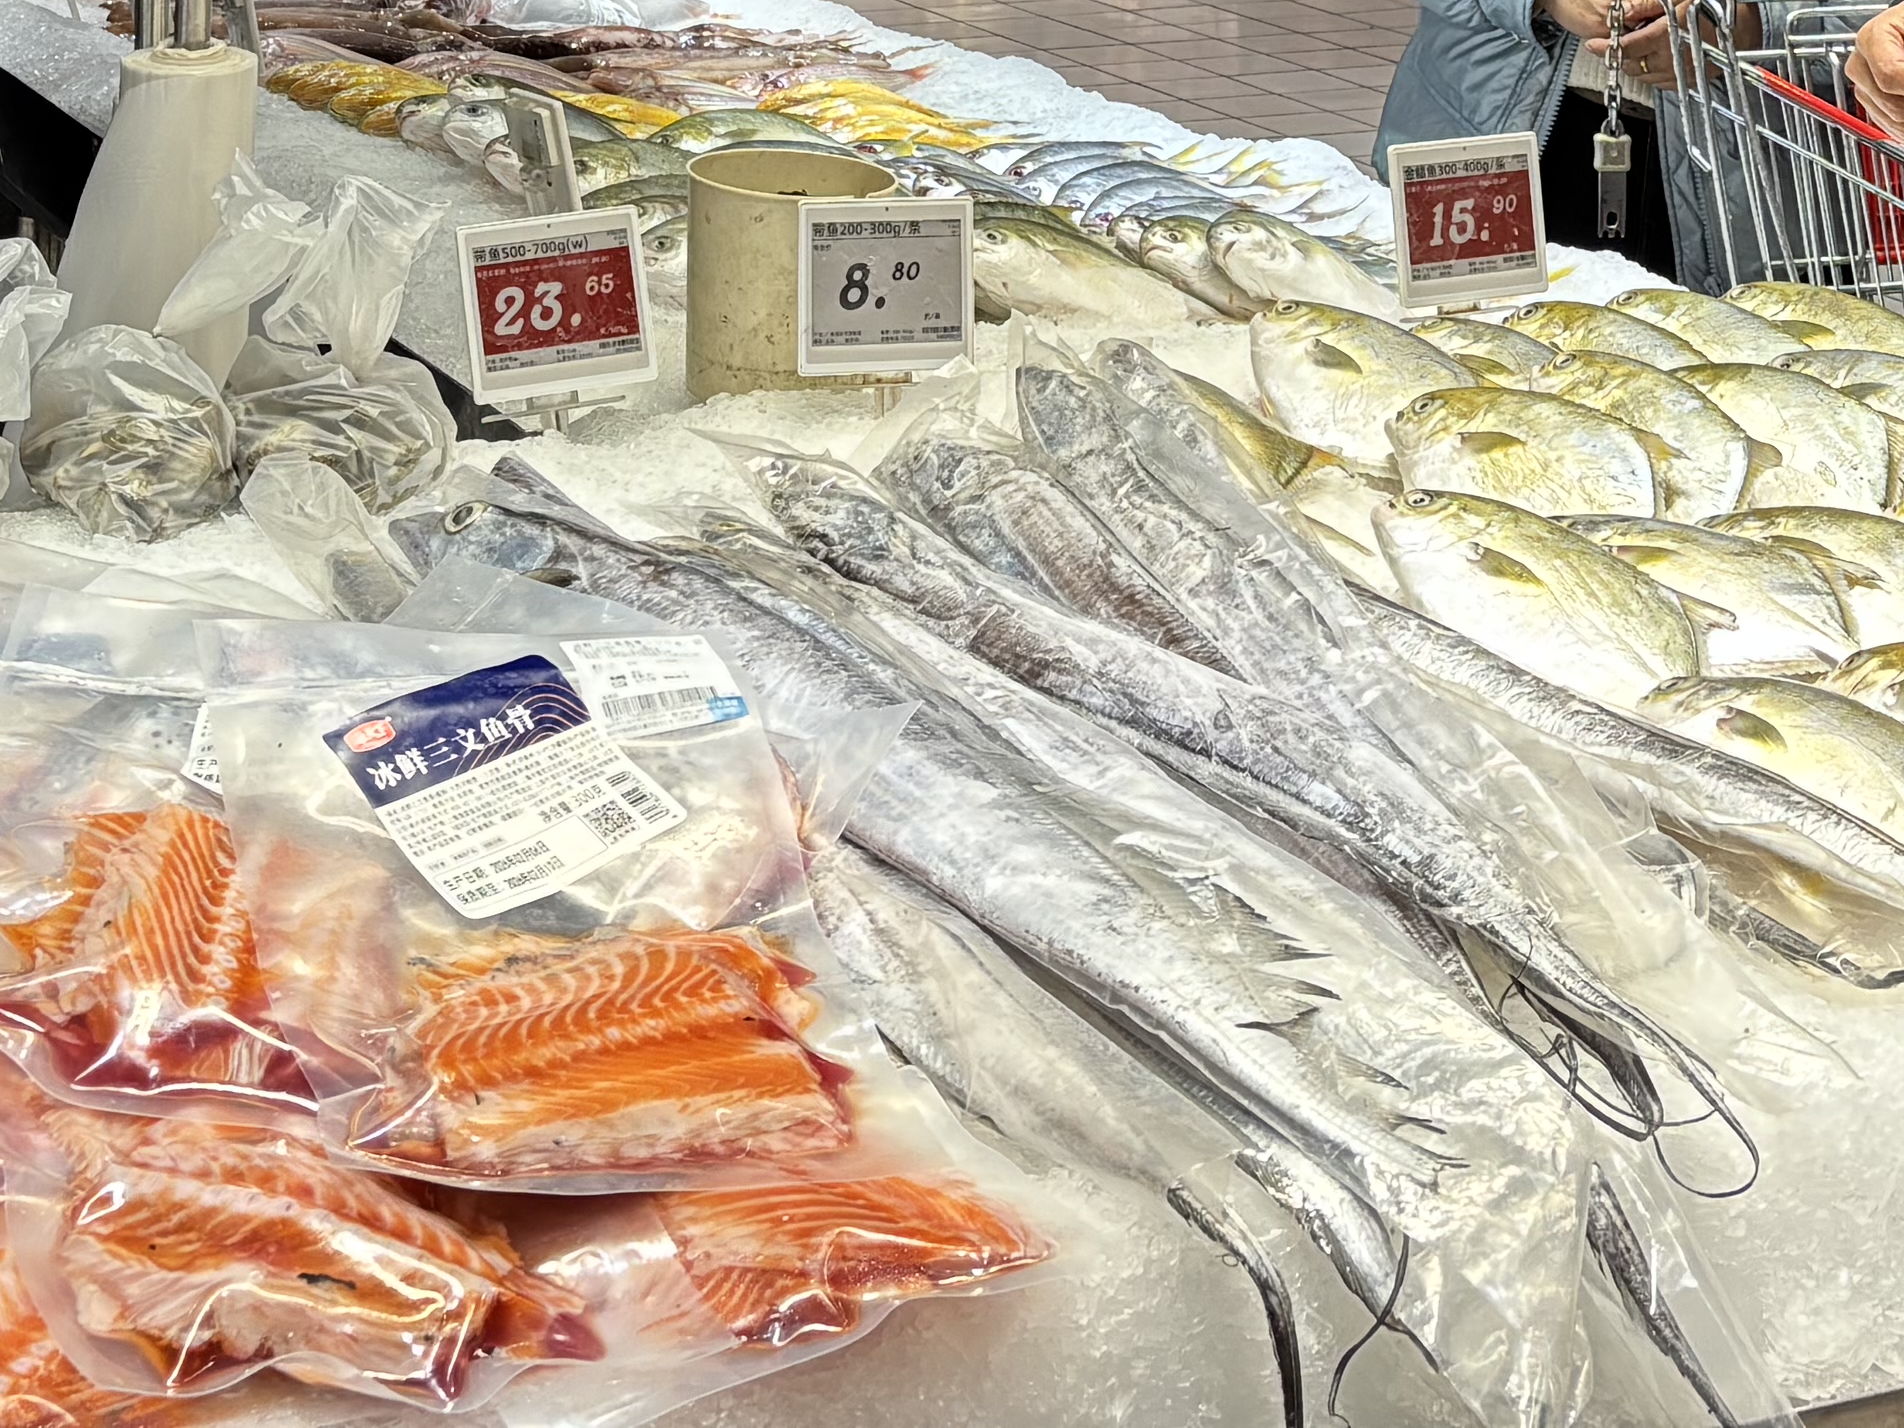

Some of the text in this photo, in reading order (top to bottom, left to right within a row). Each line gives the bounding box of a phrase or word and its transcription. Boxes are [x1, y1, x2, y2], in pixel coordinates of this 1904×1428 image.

[365, 704, 536, 790] 冰鲜三文鱼骨
